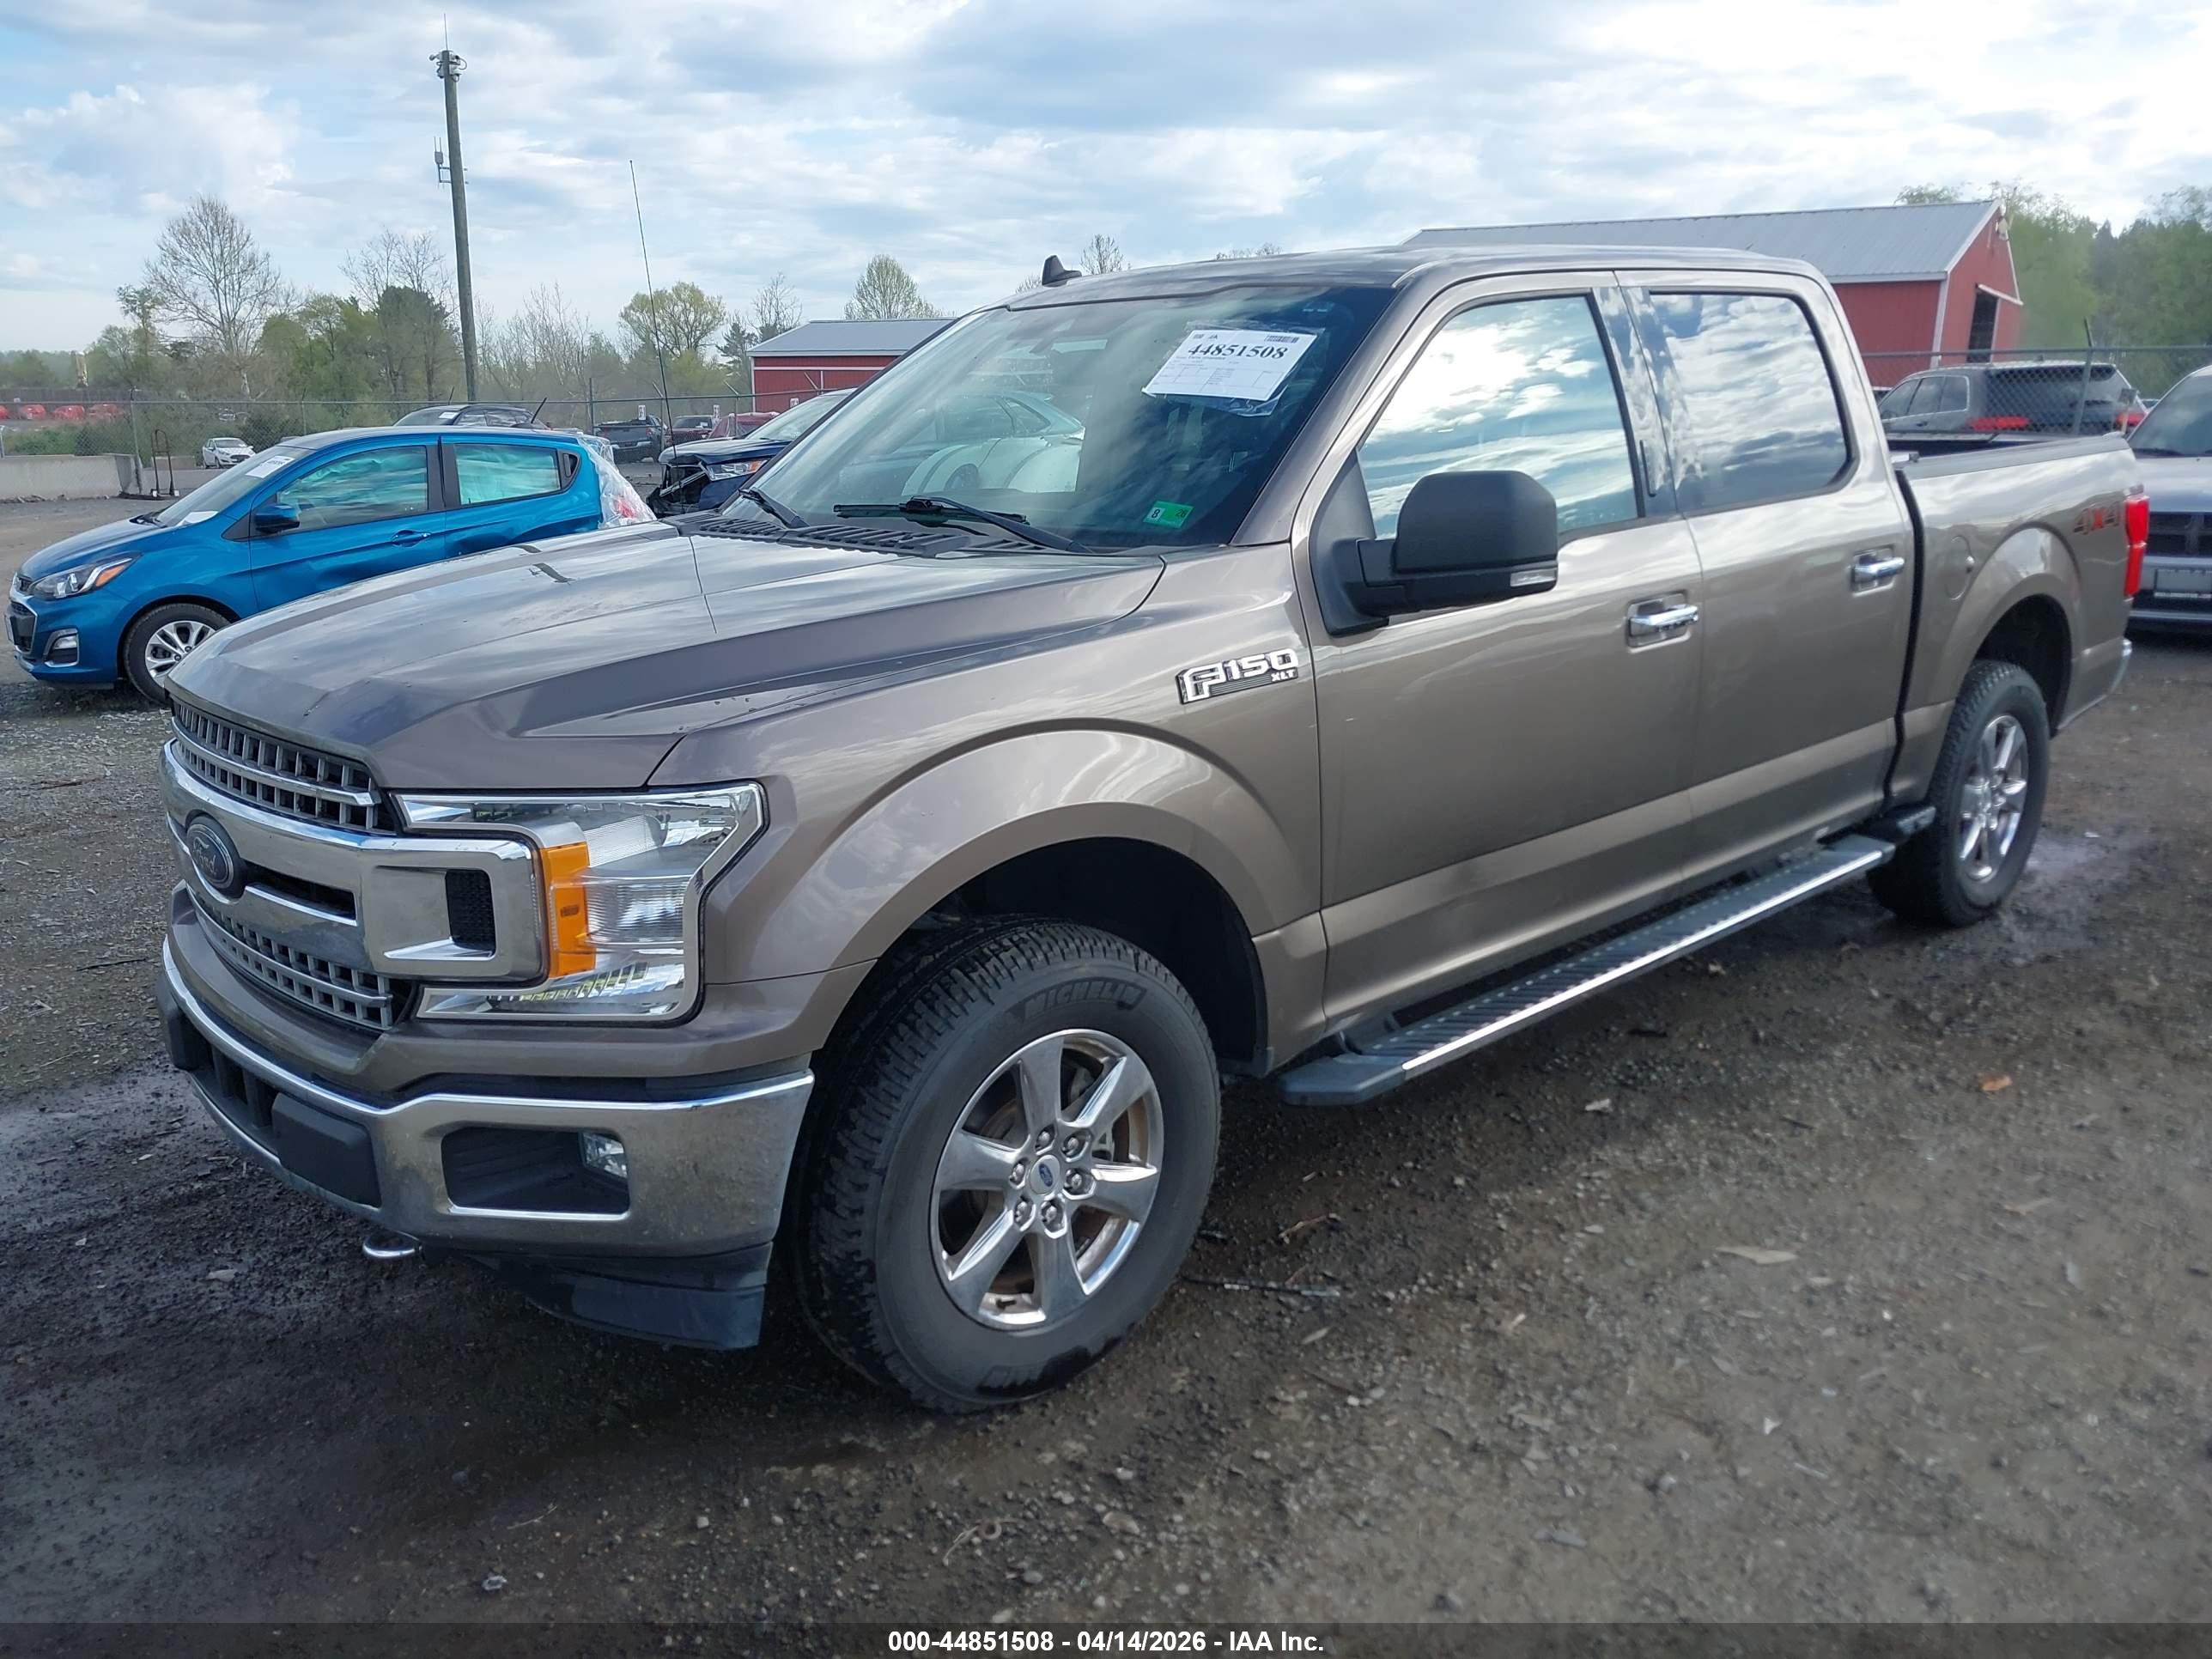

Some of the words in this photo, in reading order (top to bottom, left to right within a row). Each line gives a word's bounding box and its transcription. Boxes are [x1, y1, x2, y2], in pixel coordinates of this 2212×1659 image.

[1188, 343, 1288, 360] 44851508
[1152, 509, 1160, 518] 8
[1271, 669, 1296, 683] XLT
[191, 836, 217, 875] Ford
[1024, 980, 1140, 1018] MICHELIN
